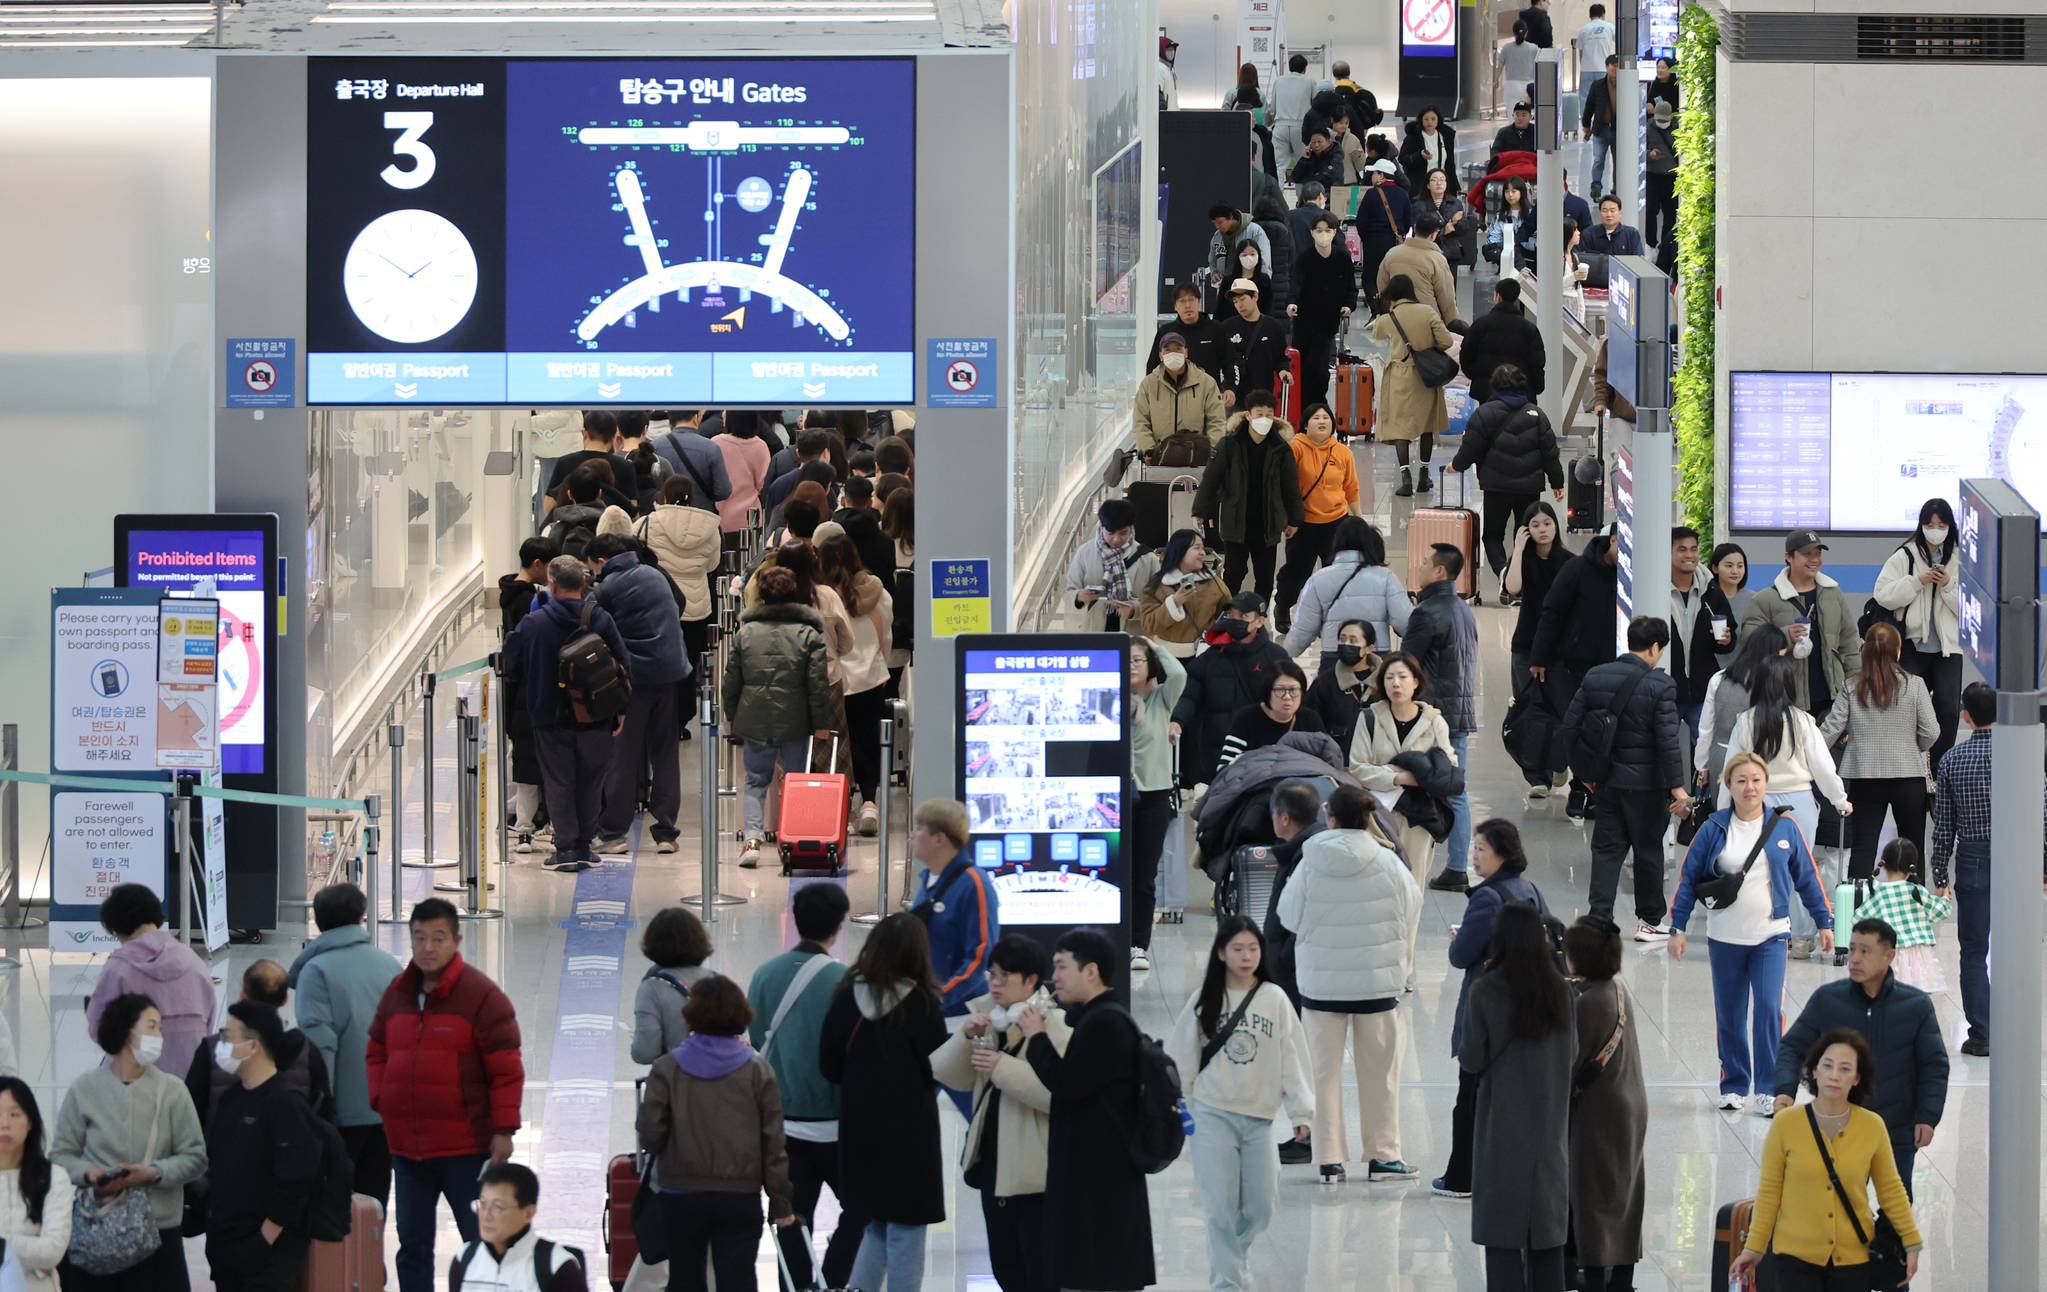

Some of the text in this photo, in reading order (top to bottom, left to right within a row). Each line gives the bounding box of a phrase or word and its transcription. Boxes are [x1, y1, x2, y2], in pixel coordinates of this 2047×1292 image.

[335, 79, 484, 99] 출국장 Departure Hall
[619, 78, 807, 105] 탑승구 안내 Gates
[627, 119, 644, 127] 126
[561, 127, 578, 135] 132
[849, 137, 865, 145] 101
[380, 111, 437, 190] 3
[669, 144, 685, 152] 121
[741, 144, 757, 152] 113
[624, 161, 637, 170] 35
[789, 161, 802, 170] 20
[611, 203, 624, 212] 40
[805, 202, 817, 211] 15
[657, 239, 669, 248] 30
[750, 253, 763, 262] 25
[680, 290, 688, 298] 4
[743, 290, 749, 298] 3
[818, 289, 830, 298] 10
[589, 296, 602, 304] 45
[651, 299, 658, 308] 5
[774, 300, 781, 309] 2
[627, 314, 634, 324] 6
[796, 314, 802, 323] 1
[236, 342, 286, 352] 사진촬영금지
[586, 341, 599, 350] 50
[846, 338, 853, 347] 5
[936, 342, 988, 352] 사진촬영금지
[343, 362, 469, 379] 일반여권 Passport
[546, 362, 673, 379] 일반여권 Passport
[751, 361, 878, 379] 일반여권 Passport
[138, 551, 257, 565] Prohibited Items
[948, 565, 973, 574] 환송객
[138, 573, 152, 581] Not
[152, 573, 190, 582] permitted
[219, 573, 233, 581] this
[234, 573, 256, 582] point:
[944, 576, 978, 586] 진입불가
[953, 604, 970, 612] 카트
[60, 613, 98, 622] Please
[101, 615, 132, 625] carry
[945, 615, 978, 625] 진입금지
[58, 628, 82, 636] own
[85, 627, 137, 638] passport
[68, 640, 153, 652] boarding pass.
[995, 656, 1090, 669] 출국장별 대기열 상황
[1021, 676, 1065, 686] 2번 출국장
[72, 706, 147, 718] 여권/탑승권은
[92, 721, 126, 732] 반드시
[1039, 728, 1065, 738] 출국장
[78, 735, 139, 747] 본인이 소지
[86, 749, 131, 761] 해주세요
[1039, 781, 1065, 790] 출국장
[85, 801, 134, 811] Farewell
[75, 814, 144, 826] passengers
[65, 827, 154, 837] are not allowed
[86, 840, 133, 850] to enter.
[92, 857, 130, 869] 환송객
[96, 871, 121, 883] 절대
[1252, 1013, 1273, 1038] PHI
